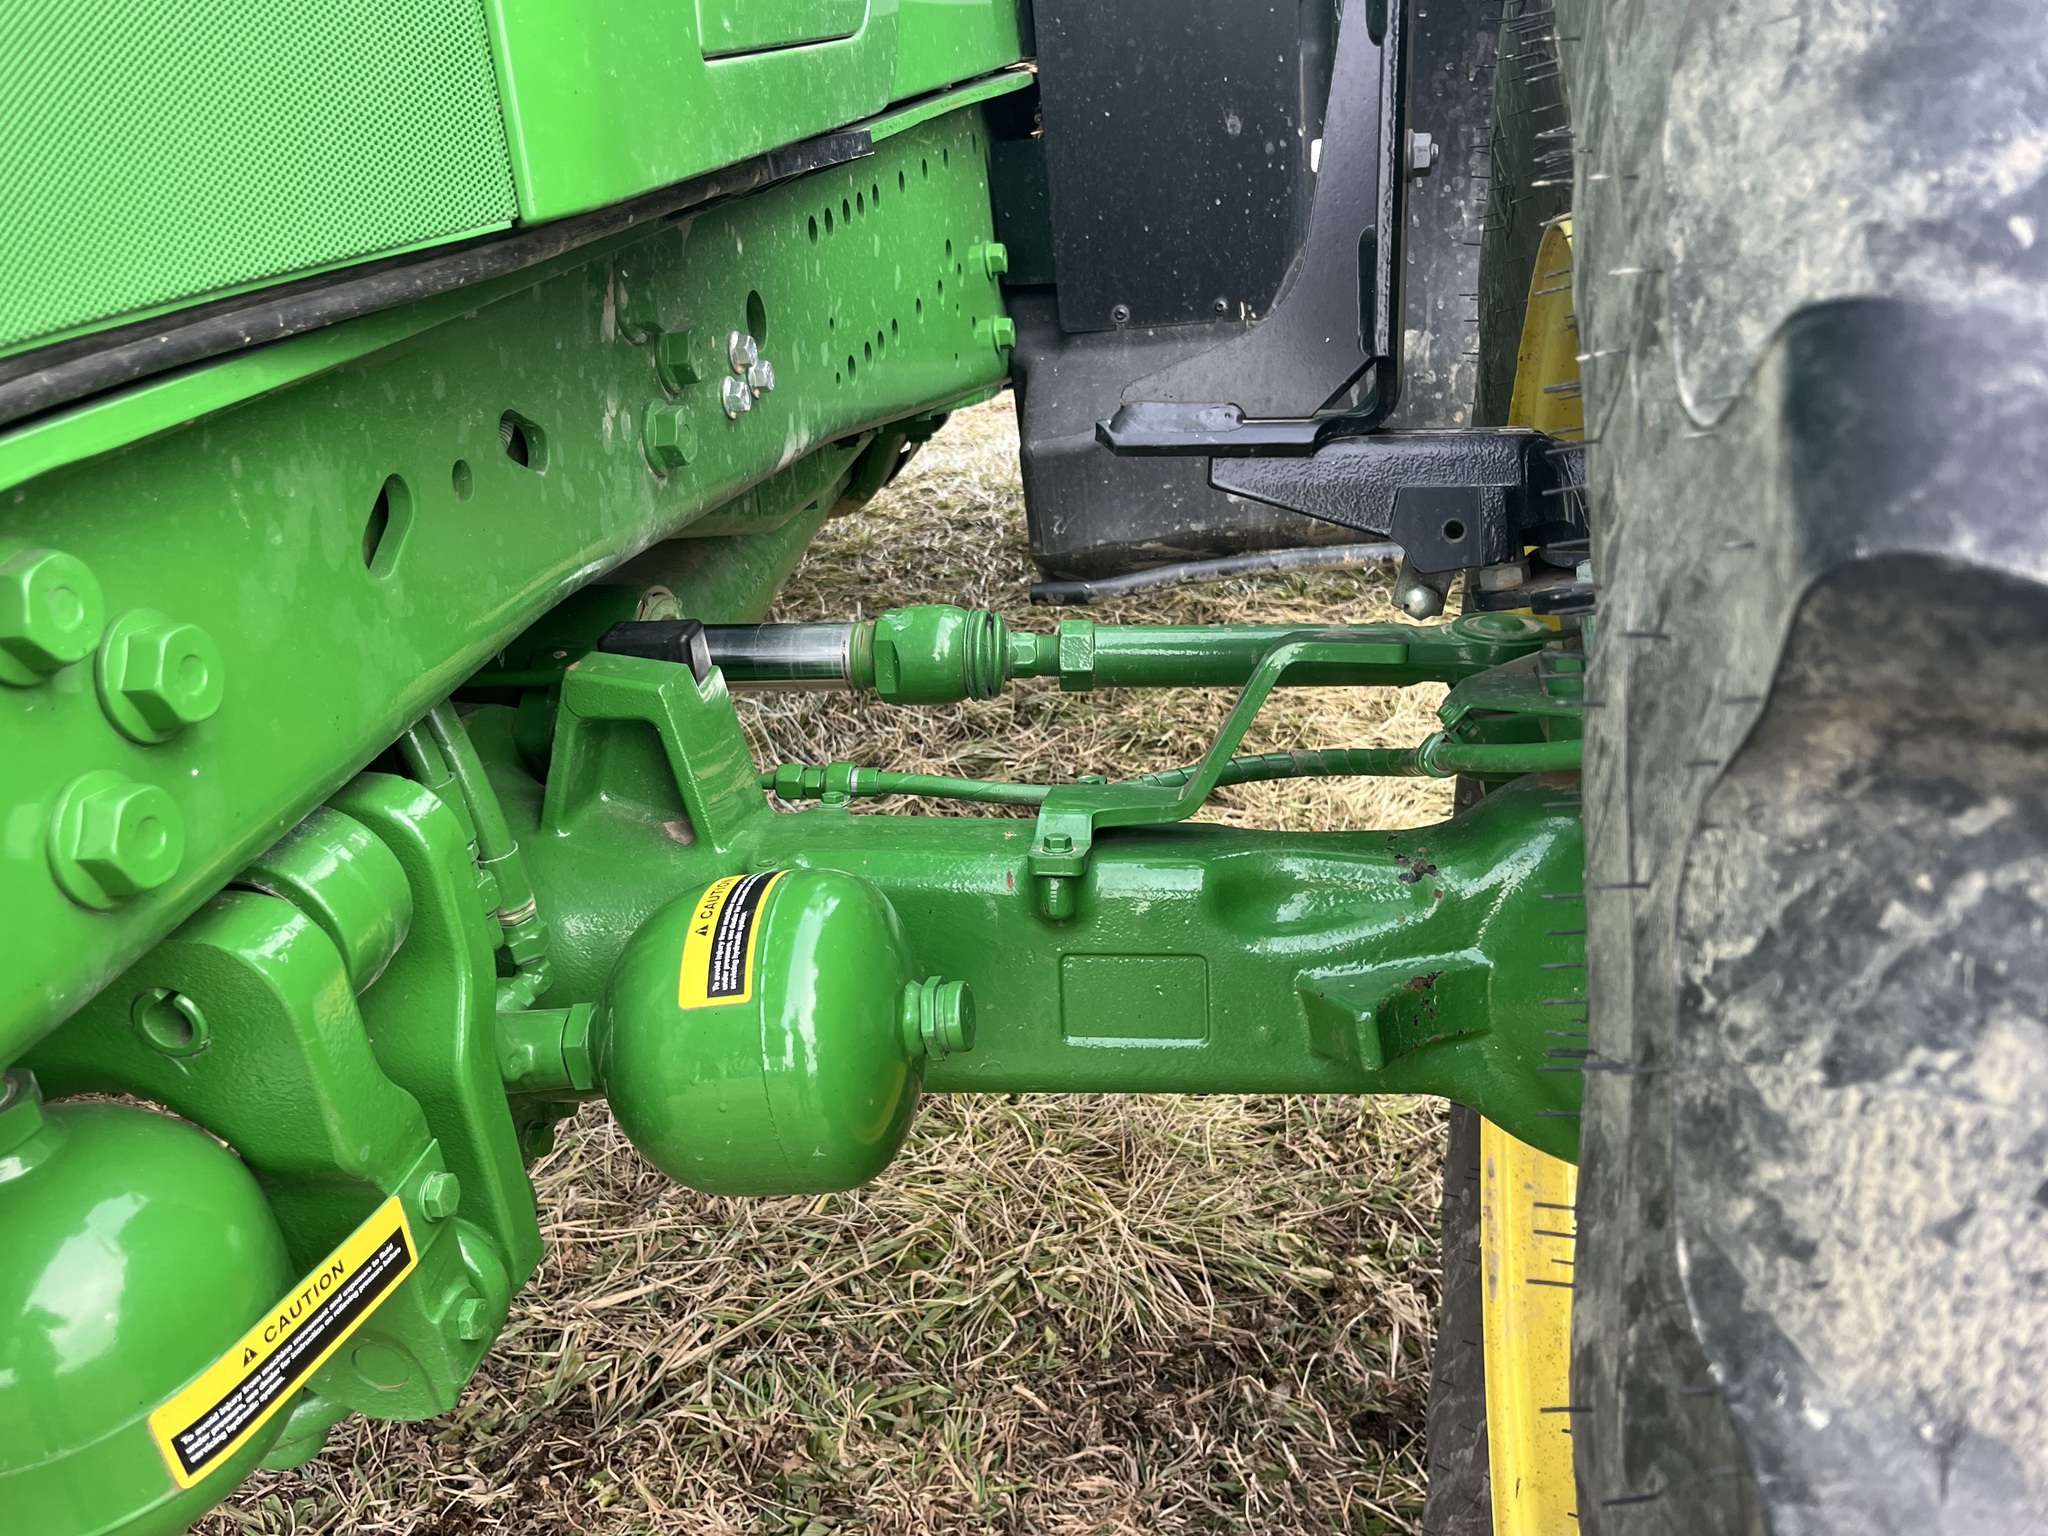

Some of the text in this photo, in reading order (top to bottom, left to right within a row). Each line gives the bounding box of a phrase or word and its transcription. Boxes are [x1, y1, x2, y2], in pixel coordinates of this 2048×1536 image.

[180, 1433, 195, 1445] To
[195, 1411, 220, 1436] avoid
[219, 1391, 243, 1416] injury
[242, 1374, 262, 1394] from
[261, 1344, 293, 1376] machine
[292, 1307, 329, 1346] movement
[329, 1294, 343, 1310] and
[343, 1266, 372, 1296] exposure
[372, 1258, 380, 1268] to
[379, 1242, 394, 1260] fluid
[185, 1432, 210, 1455] under
[210, 1403, 246, 1436] pressure,
[245, 1388, 259, 1404] see
[259, 1367, 281, 1390] dealer
[280, 1356, 291, 1371] for
[291, 1324, 325, 1359] instruction
[325, 1315, 334, 1326] on
[334, 1291, 359, 1318] relieving
[358, 1265, 384, 1294] pressure
[383, 1246, 401, 1268] before
[264, 1259, 345, 1343] CAUTION
[190, 1376, 286, 1463] servicing hydraulic system.
